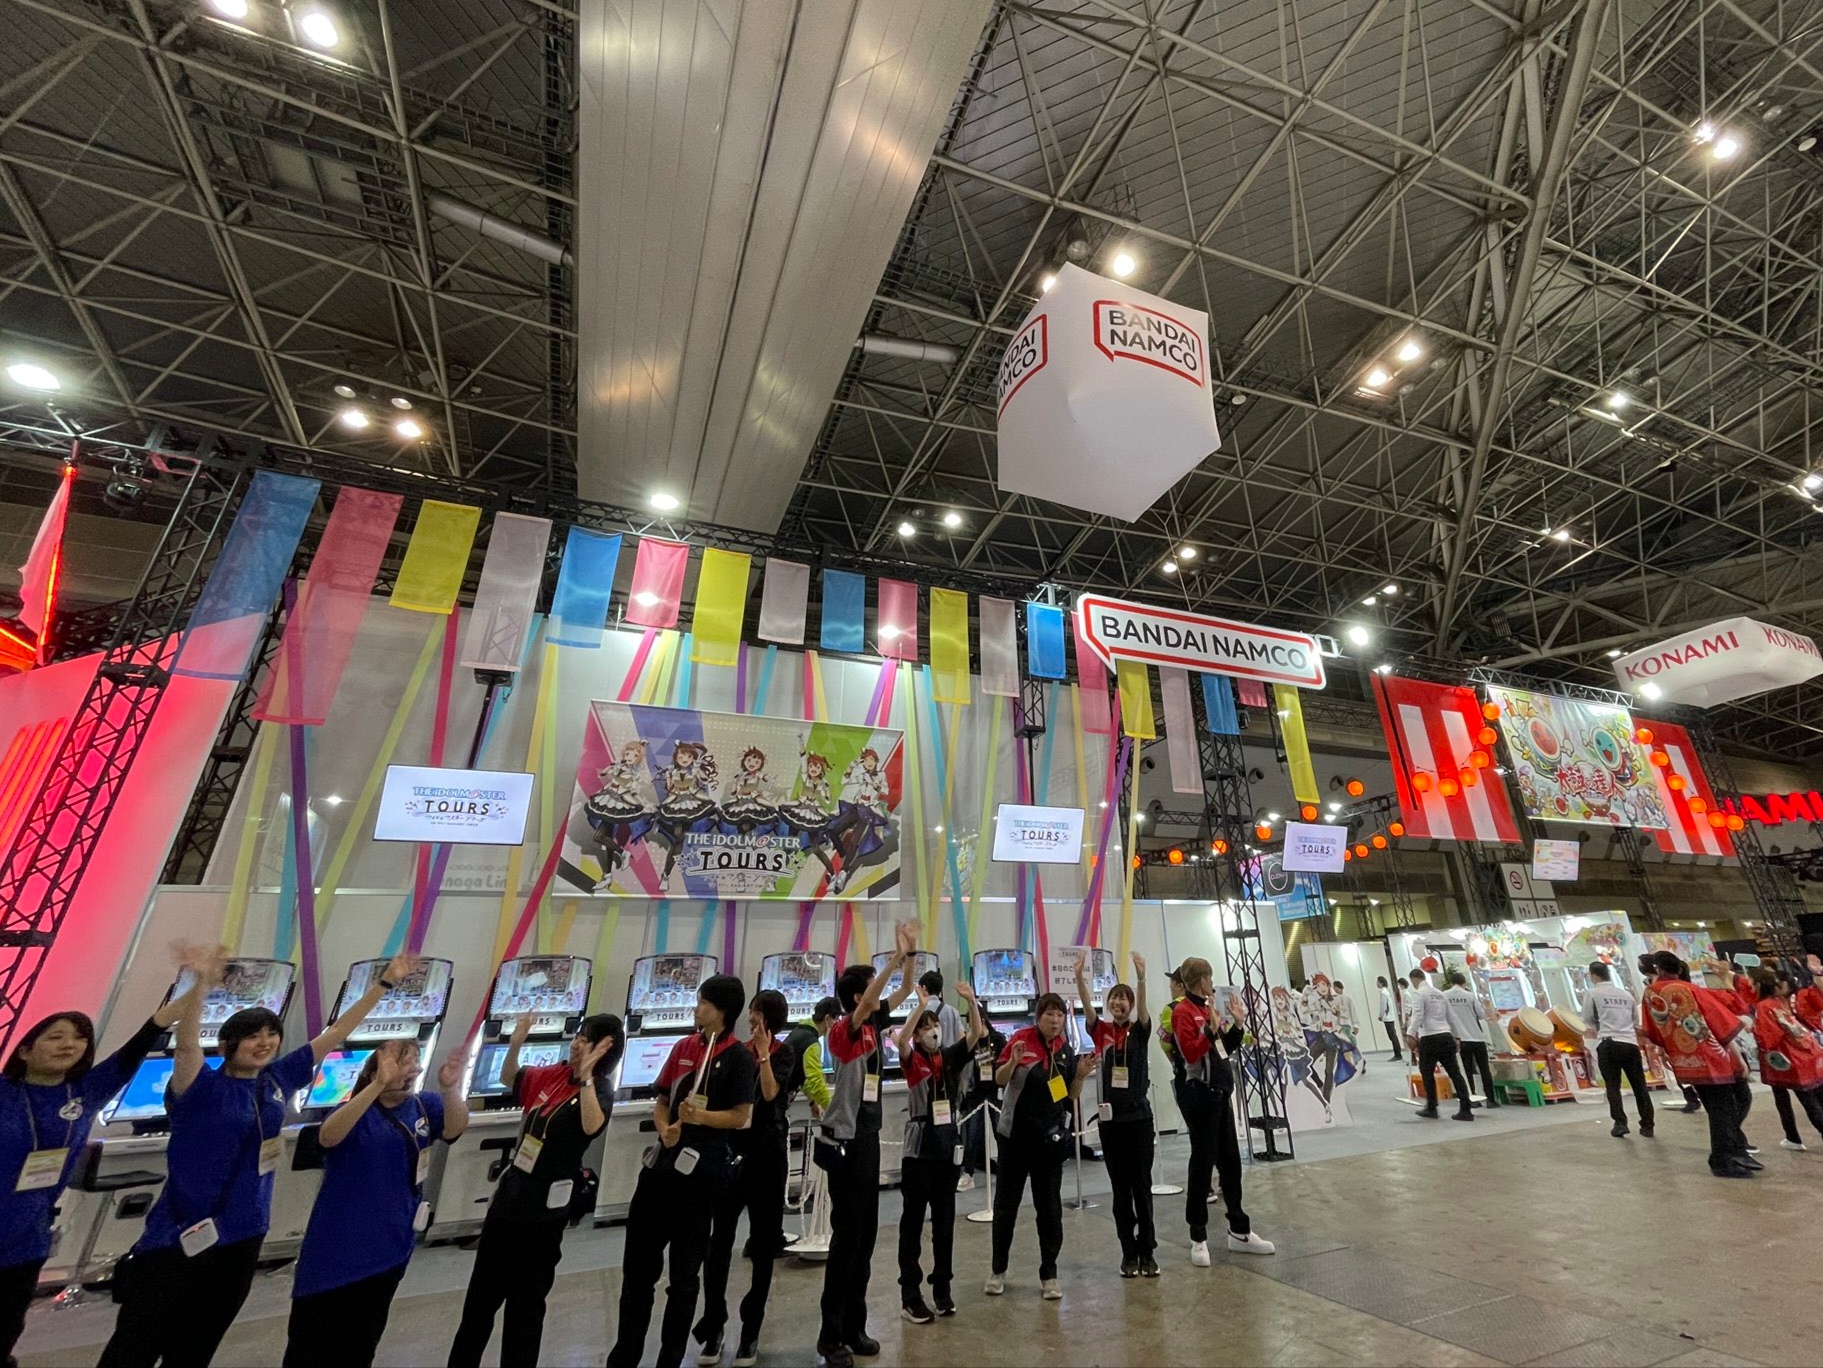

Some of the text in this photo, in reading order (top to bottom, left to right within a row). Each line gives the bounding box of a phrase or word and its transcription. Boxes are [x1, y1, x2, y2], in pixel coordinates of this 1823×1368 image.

[1109, 310, 1195, 351] BANDAI
[1110, 328, 1197, 371] NAMCO
[1101, 615, 1307, 670] BANDAI NAMCO
[1625, 631, 1740, 682] KONAMI
[424, 800, 490, 815] TOURS
[685, 833, 711, 846] THE
[1021, 830, 1060, 841] TOURS
[1302, 844, 1330, 855] TOURS
[700, 851, 784, 872] TOURS
[1603, 998, 1628, 1006] STAFF
[656, 1013, 685, 1021] TOURS
[789, 1007, 811, 1015] OURS
[367, 1023, 403, 1032] TOURS
